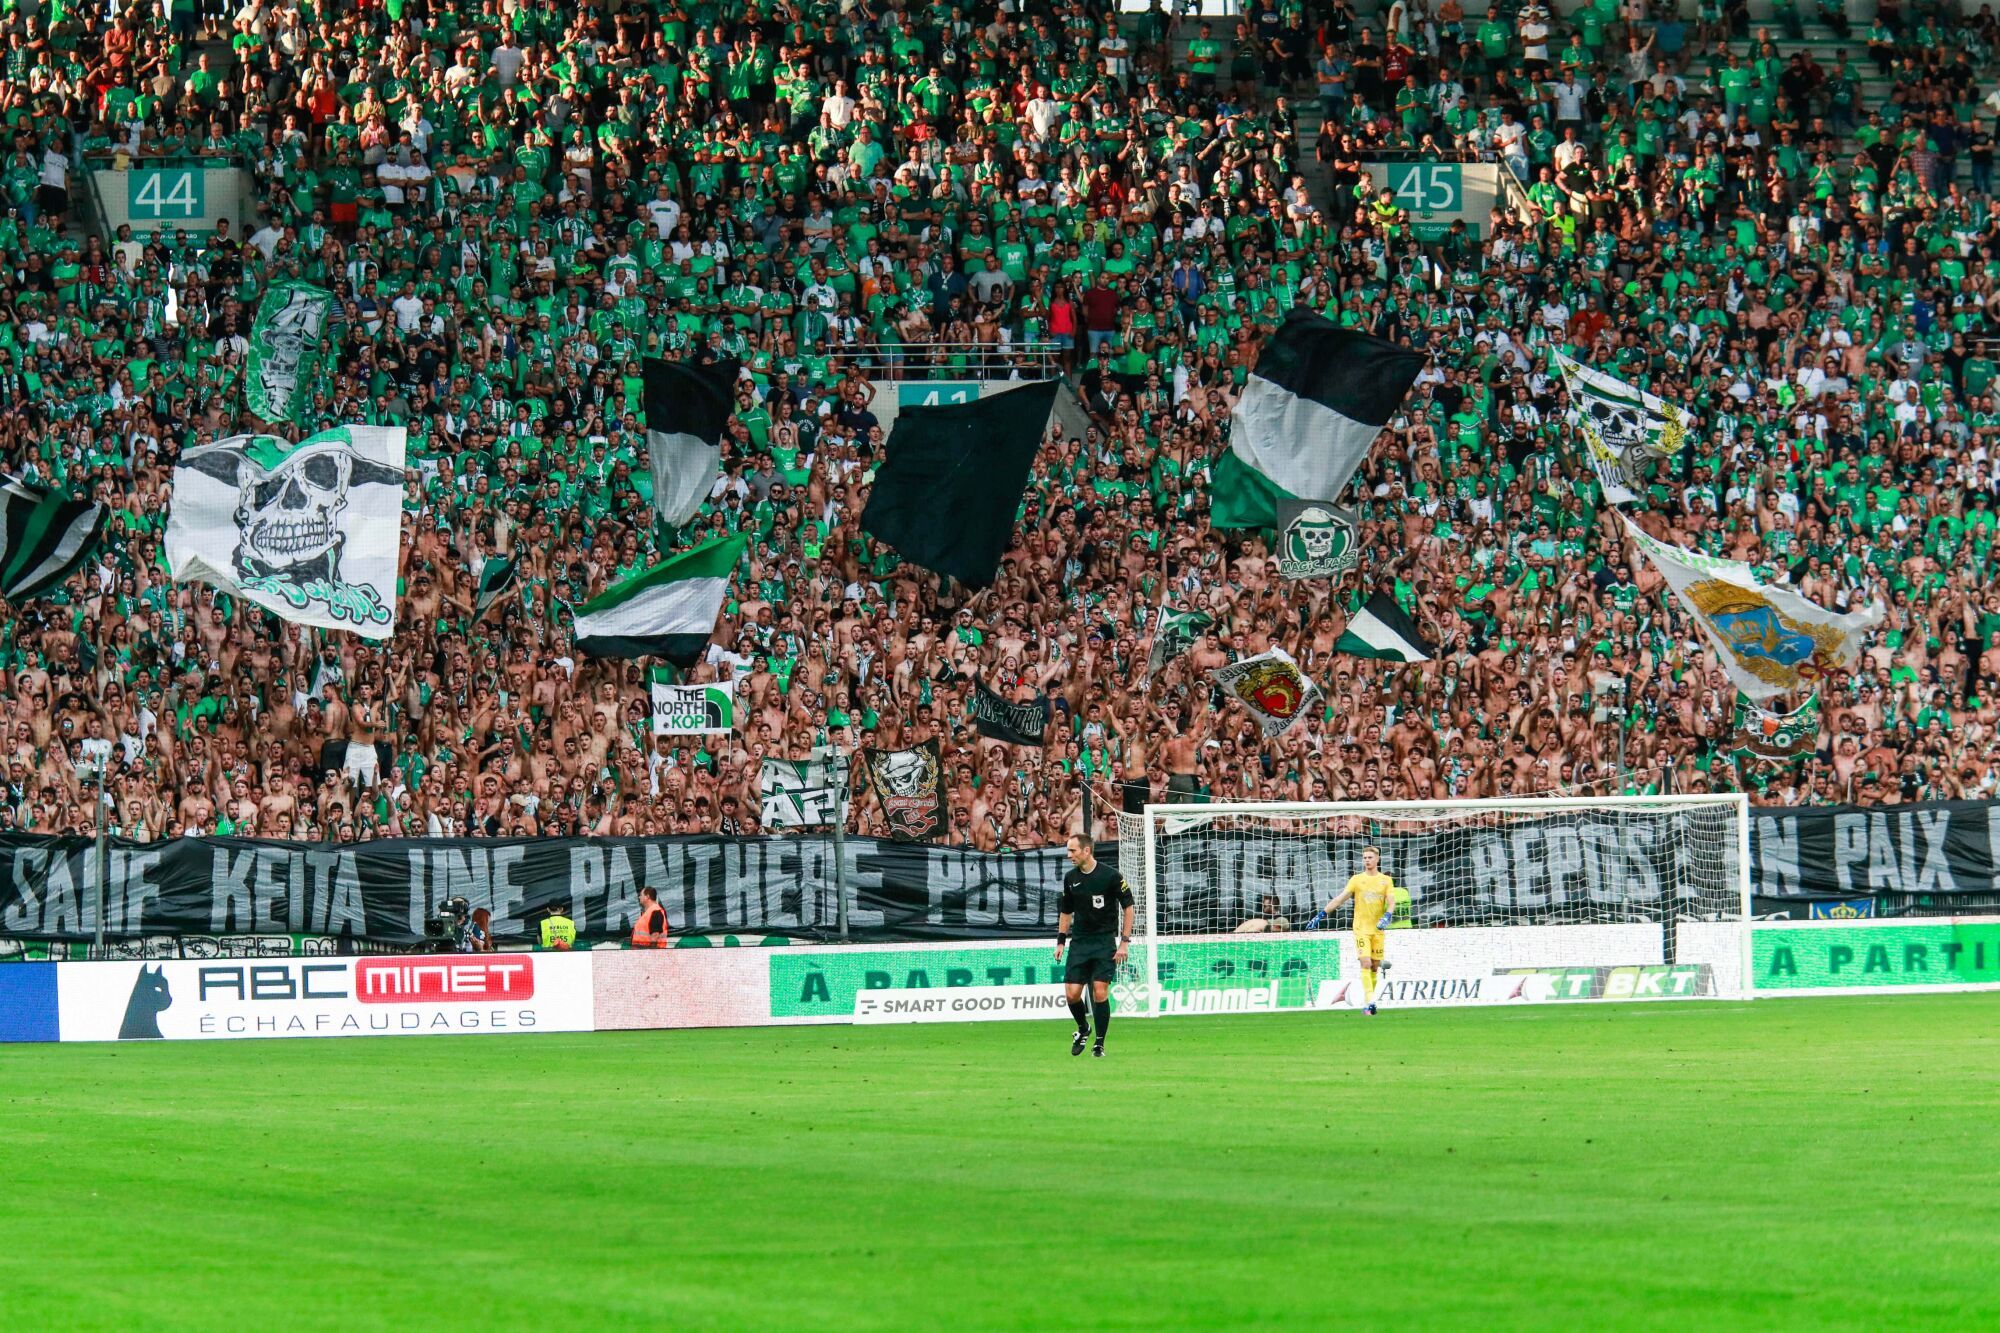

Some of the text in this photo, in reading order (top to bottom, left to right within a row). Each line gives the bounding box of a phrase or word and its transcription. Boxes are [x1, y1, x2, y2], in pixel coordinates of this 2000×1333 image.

[135, 172, 198, 216] 44
[1396, 166, 1454, 209] 45
[674, 688, 705, 701] THE
[653, 701, 705, 715] NORTH
[672, 714, 705, 729] KOP
[5, 847, 161, 934] SALIF
[211, 847, 367, 936] KEITA
[409, 846, 525, 936] UNE
[569, 840, 885, 932] PANTHERE
[1834, 809, 1958, 891] PAIX
[1829, 941, 2000, 974] PARTI
[199, 964, 348, 1002] ABC
[1378, 978, 1482, 1001] ATRIUM
[1607, 972, 1696, 995] BKT
[883, 994, 1068, 1014] SMART GOOD THING
[1157, 979, 1278, 1012] hummel
[199, 1010, 537, 1034] ÉCHAFAUDAGES
